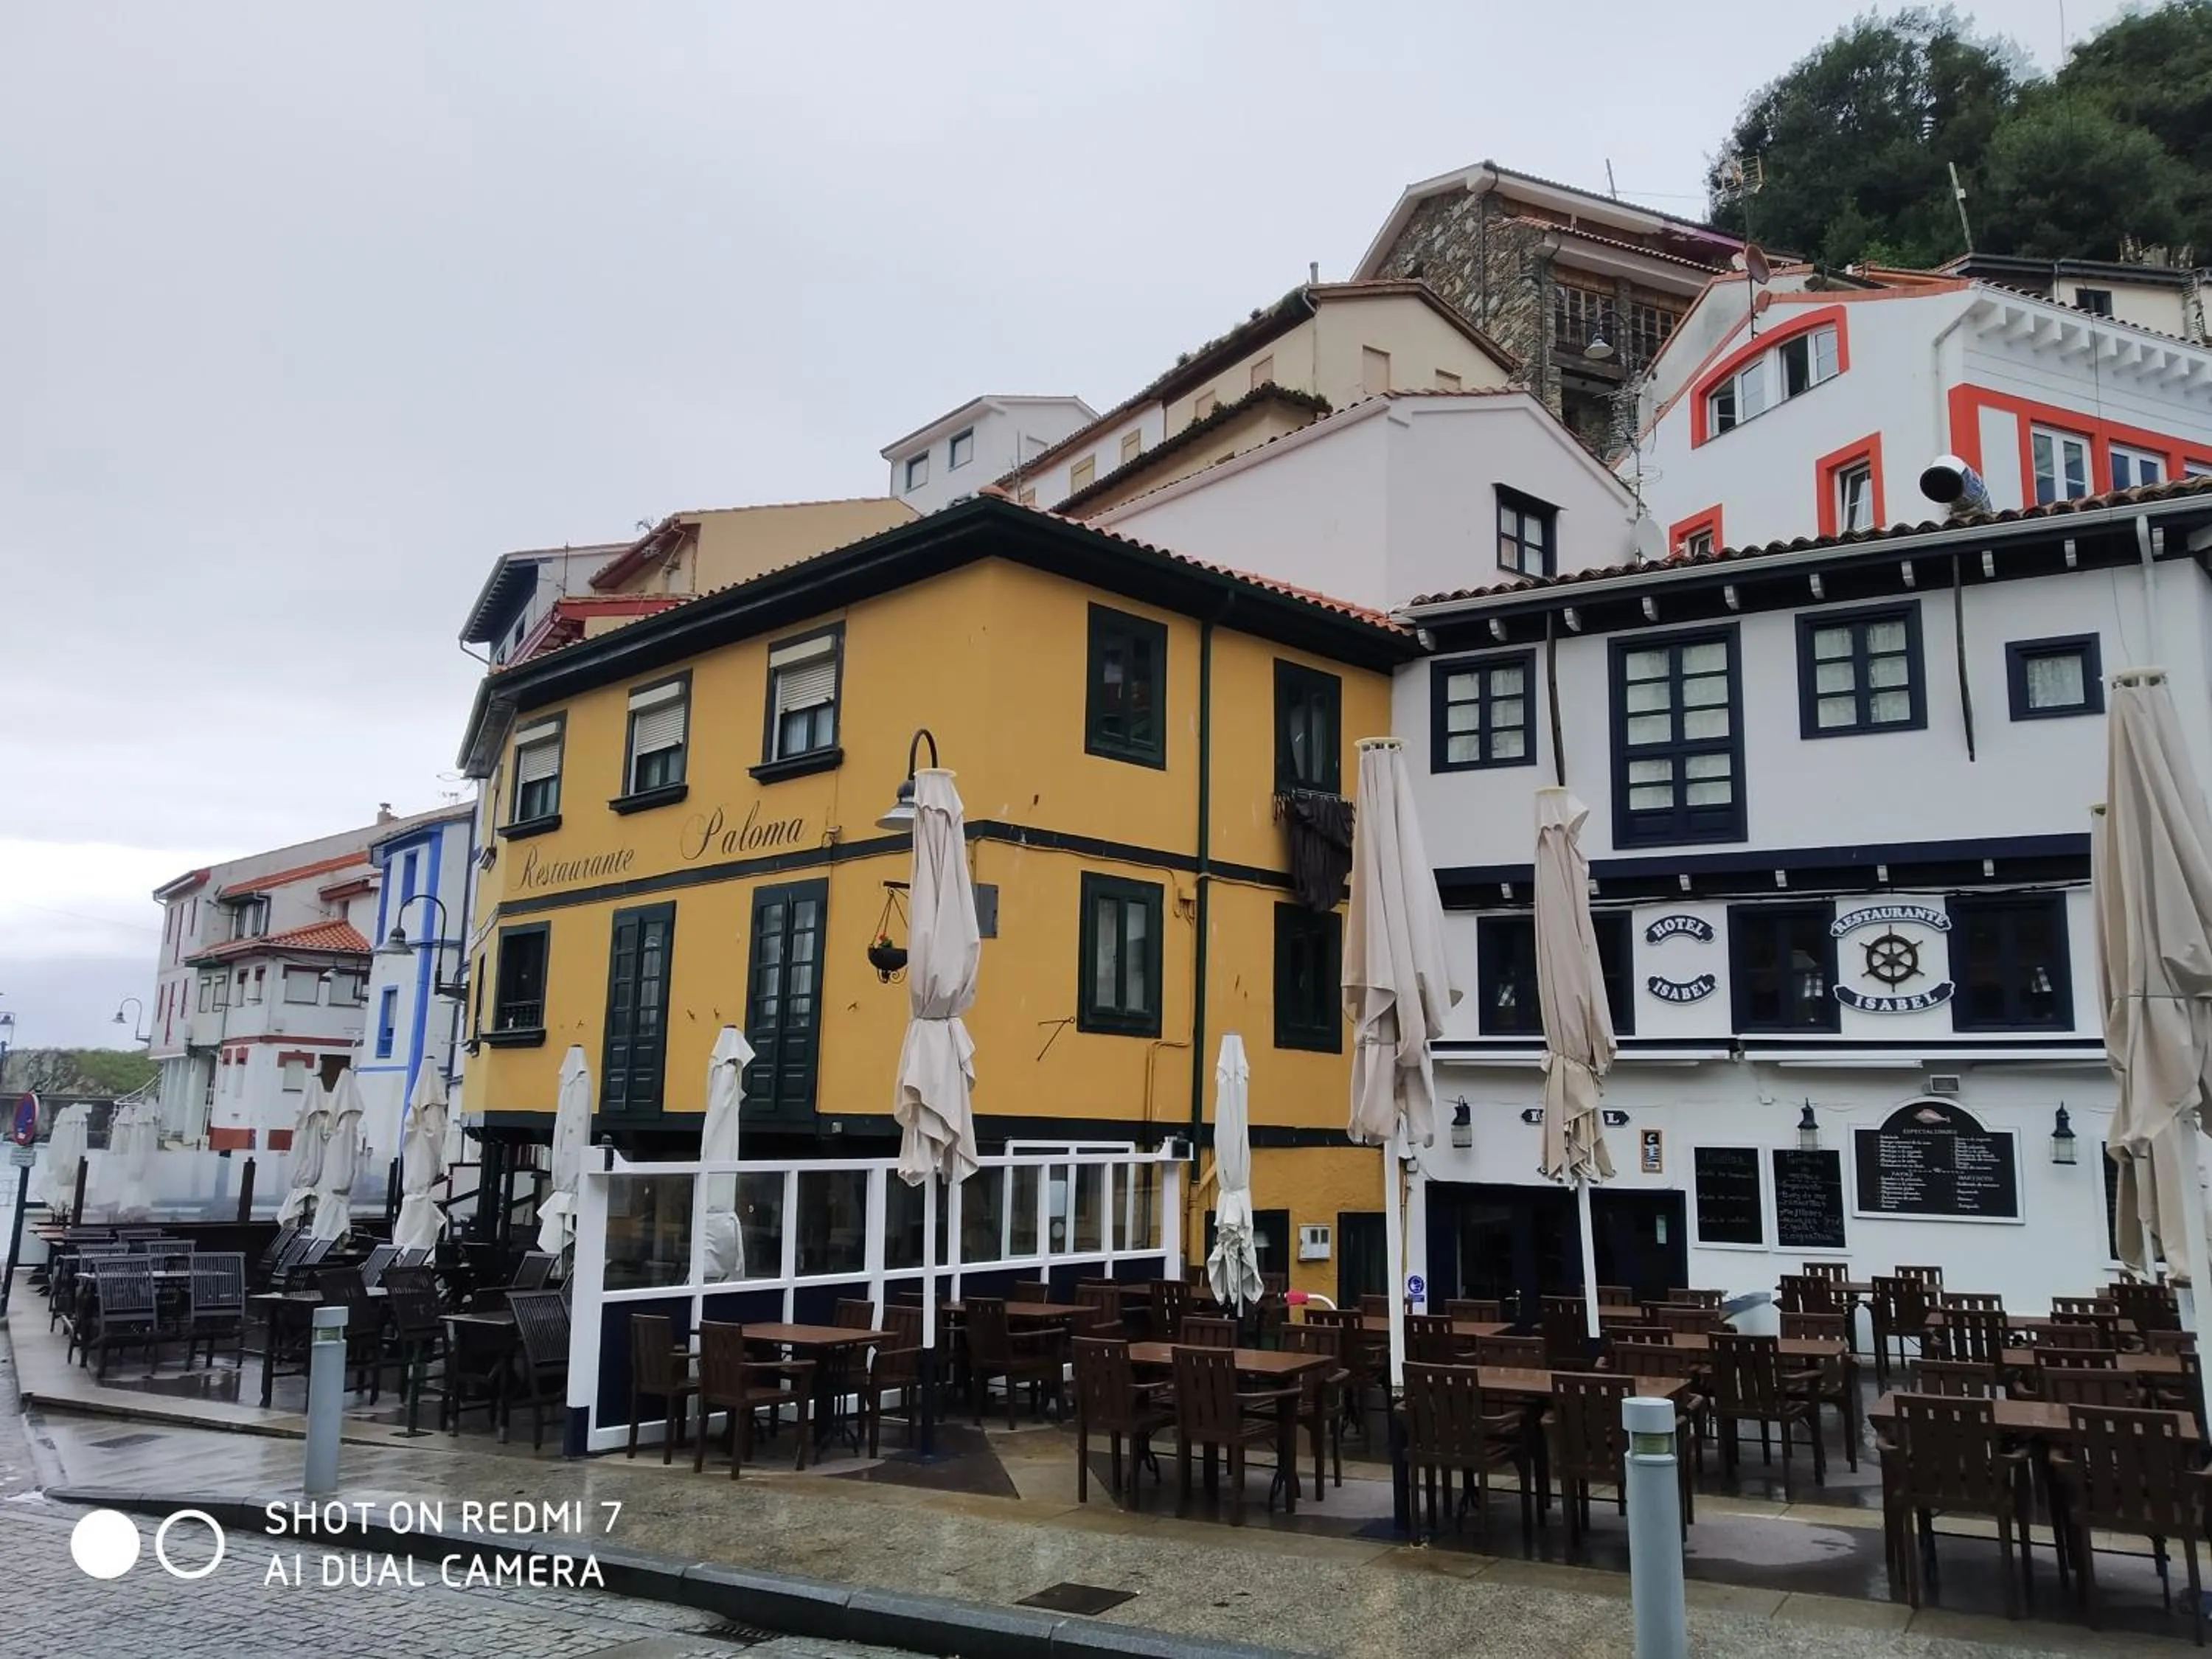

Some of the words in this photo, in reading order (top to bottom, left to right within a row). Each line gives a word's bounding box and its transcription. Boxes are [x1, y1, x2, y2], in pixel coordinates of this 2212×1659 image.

[518, 845, 635, 889] Restaurante
[680, 800, 805, 860] Paloma
[1652, 917, 1705, 937] HOTEL
[1833, 905, 1945, 933] RESTAURANTE
[1652, 981, 1711, 1000] ISABEL
[1854, 992, 1938, 1012] ISABEL
